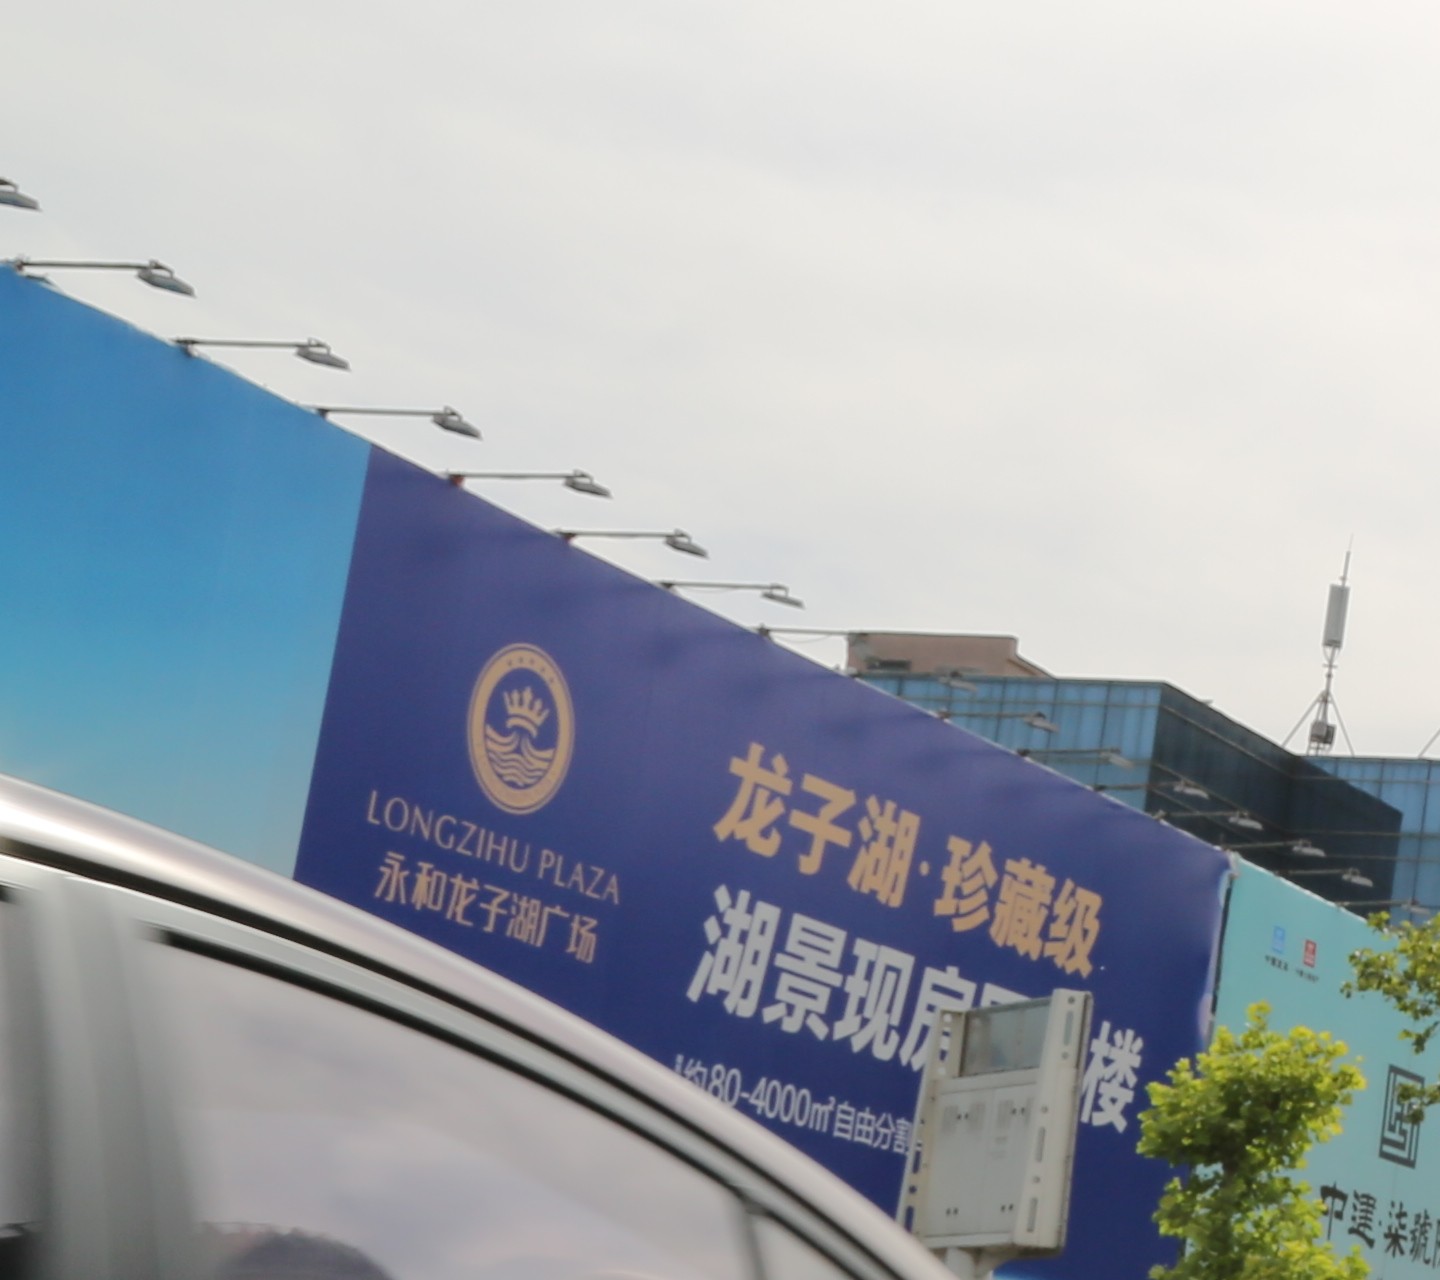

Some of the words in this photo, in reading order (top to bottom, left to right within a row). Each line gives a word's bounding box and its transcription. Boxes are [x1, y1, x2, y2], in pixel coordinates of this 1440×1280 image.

[367, 789, 530, 874] LONGZIHU
[537, 848, 620, 906] PLAZA
[374, 850, 599, 964] 永和龙子湖广场
[713, 742, 1103, 979] 龙子湖·珍藏级
[686, 883, 1144, 1133] 湖景现房楼
